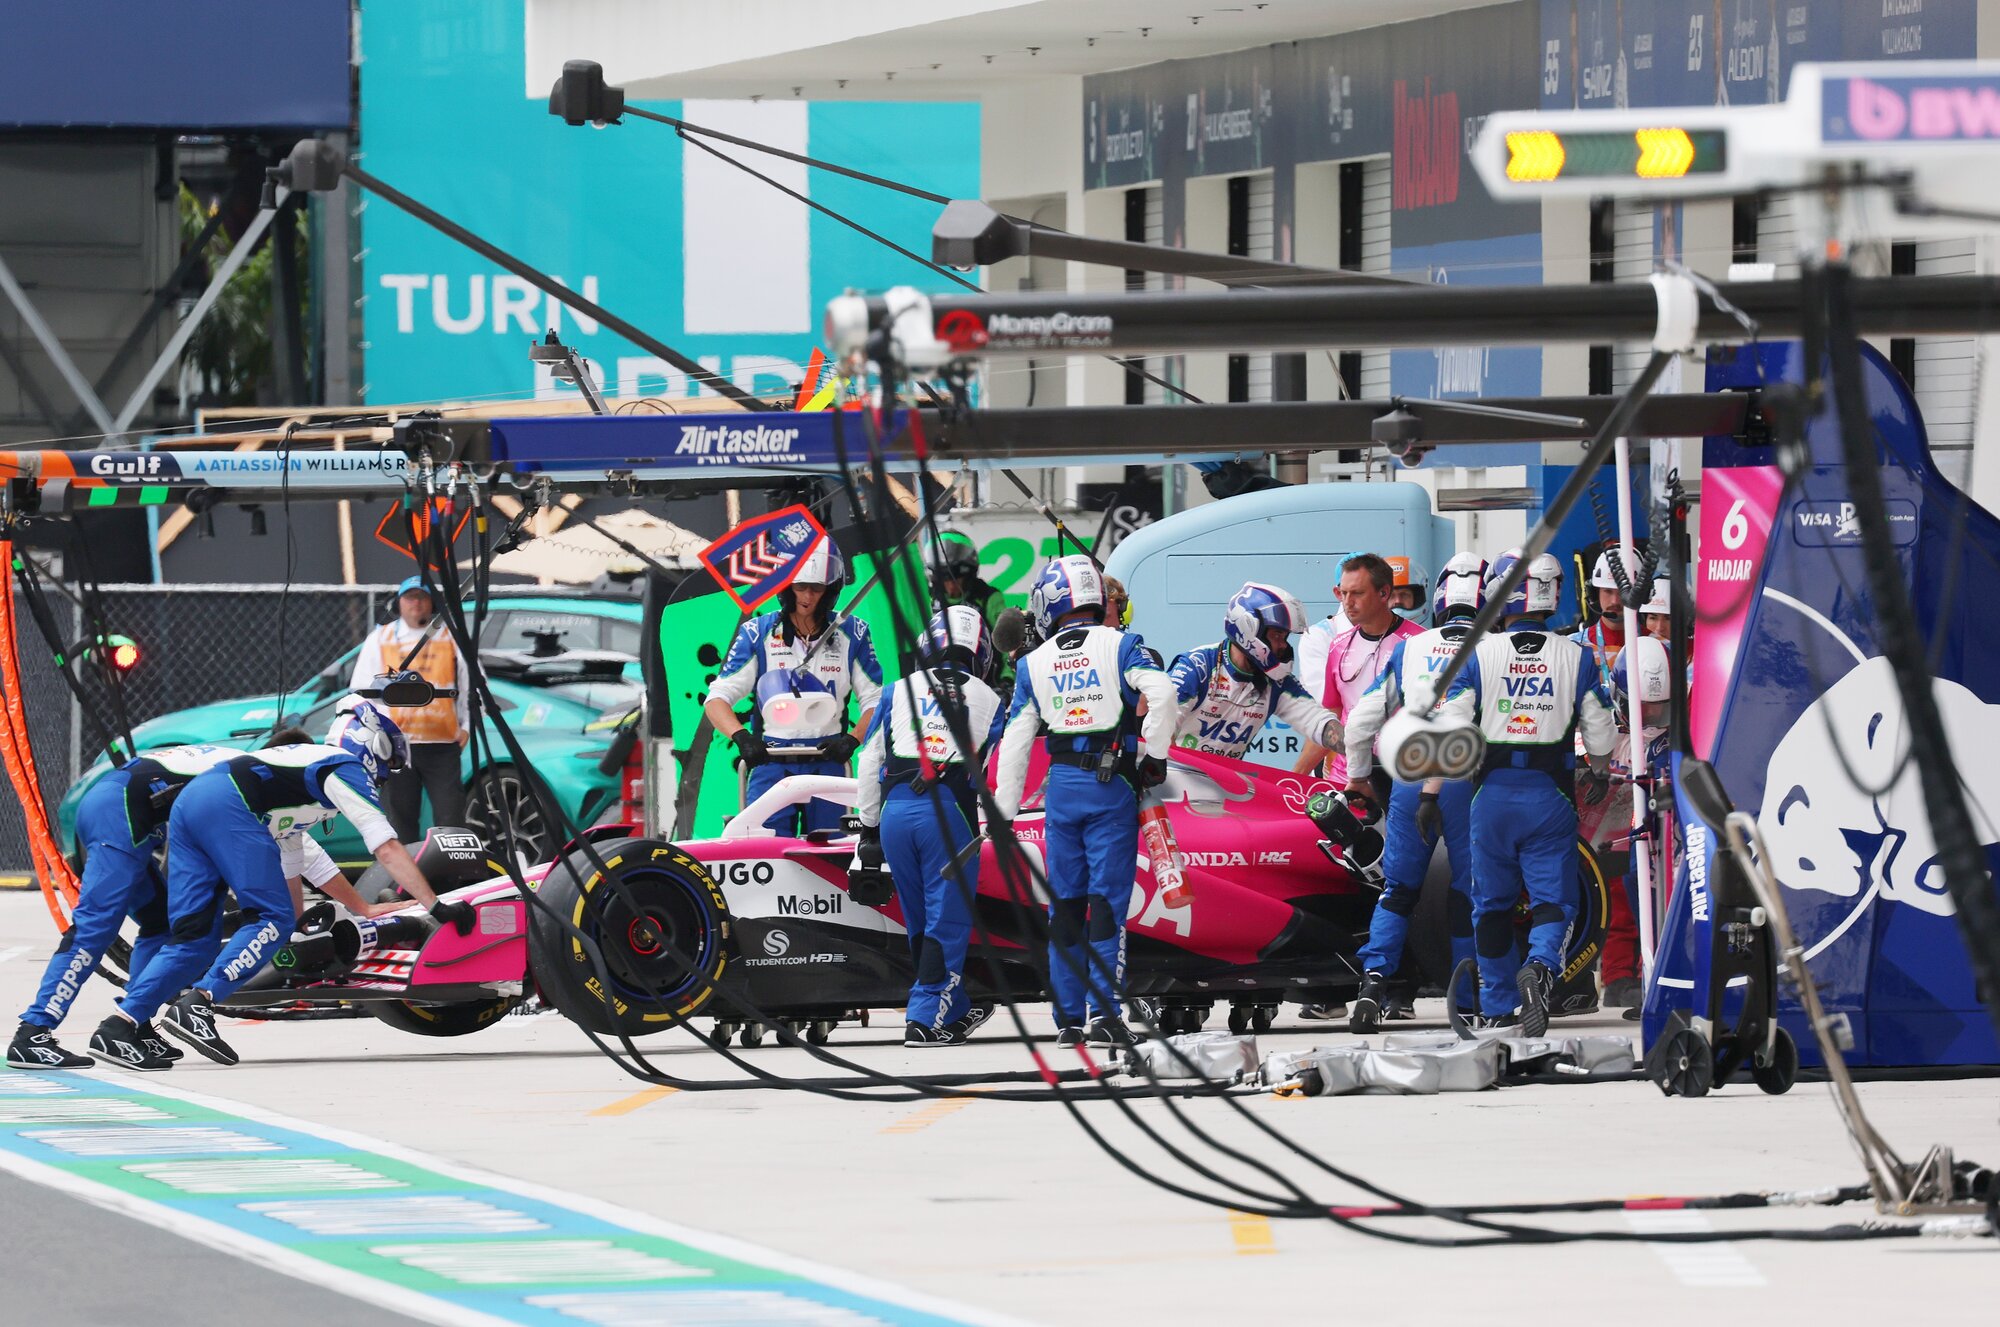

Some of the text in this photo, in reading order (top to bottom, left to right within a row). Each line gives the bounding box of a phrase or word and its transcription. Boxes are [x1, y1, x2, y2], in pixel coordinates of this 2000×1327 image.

[1687, 14, 1704, 72] 23
[1544, 39, 1561, 96] 55
[1727, 44, 1765, 82] ALBON
[1106, 129, 1144, 162] BORTOLETO
[380, 273, 599, 335] TURN
[988, 312, 1113, 337] MoneyGram
[674, 424, 799, 455] Airtasker
[90, 454, 162, 475] Gulf
[209, 457, 302, 473] ATLASSIAN
[305, 457, 392, 473] WILLIAMS
[1720, 499, 1749, 551] 6
[1797, 513, 1832, 527] VISA
[1707, 559, 1753, 582] HADJAR
[1432, 646, 1459, 655] HUG
[820, 665, 841, 673] HUGO
[1053, 657, 1091, 672] HUGO
[1509, 663, 1548, 675] HUGO
[1048, 668, 1101, 694] VISA
[1500, 676, 1554, 697] VISA
[1065, 693, 1104, 705] Cash App
[1512, 701, 1554, 713] Cash App
[1064, 716, 1094, 727] Red Bull
[1242, 710, 1264, 720] HUGO
[1197, 717, 1255, 745] VISA
[1506, 725, 1538, 736] Red Bull
[1200, 743, 1224, 757] Cash
[440, 835, 476, 848] NEFT
[448, 851, 477, 860] VODKA
[1166, 851, 1249, 867] ONDA
[671, 853, 727, 911] ZERO
[706, 861, 775, 886] UGO
[1686, 822, 1709, 924] Airtasker
[776, 892, 843, 915] Mobil
[744, 955, 808, 967] STUDENT.COM
[1561, 941, 1599, 983] PIRELLI
